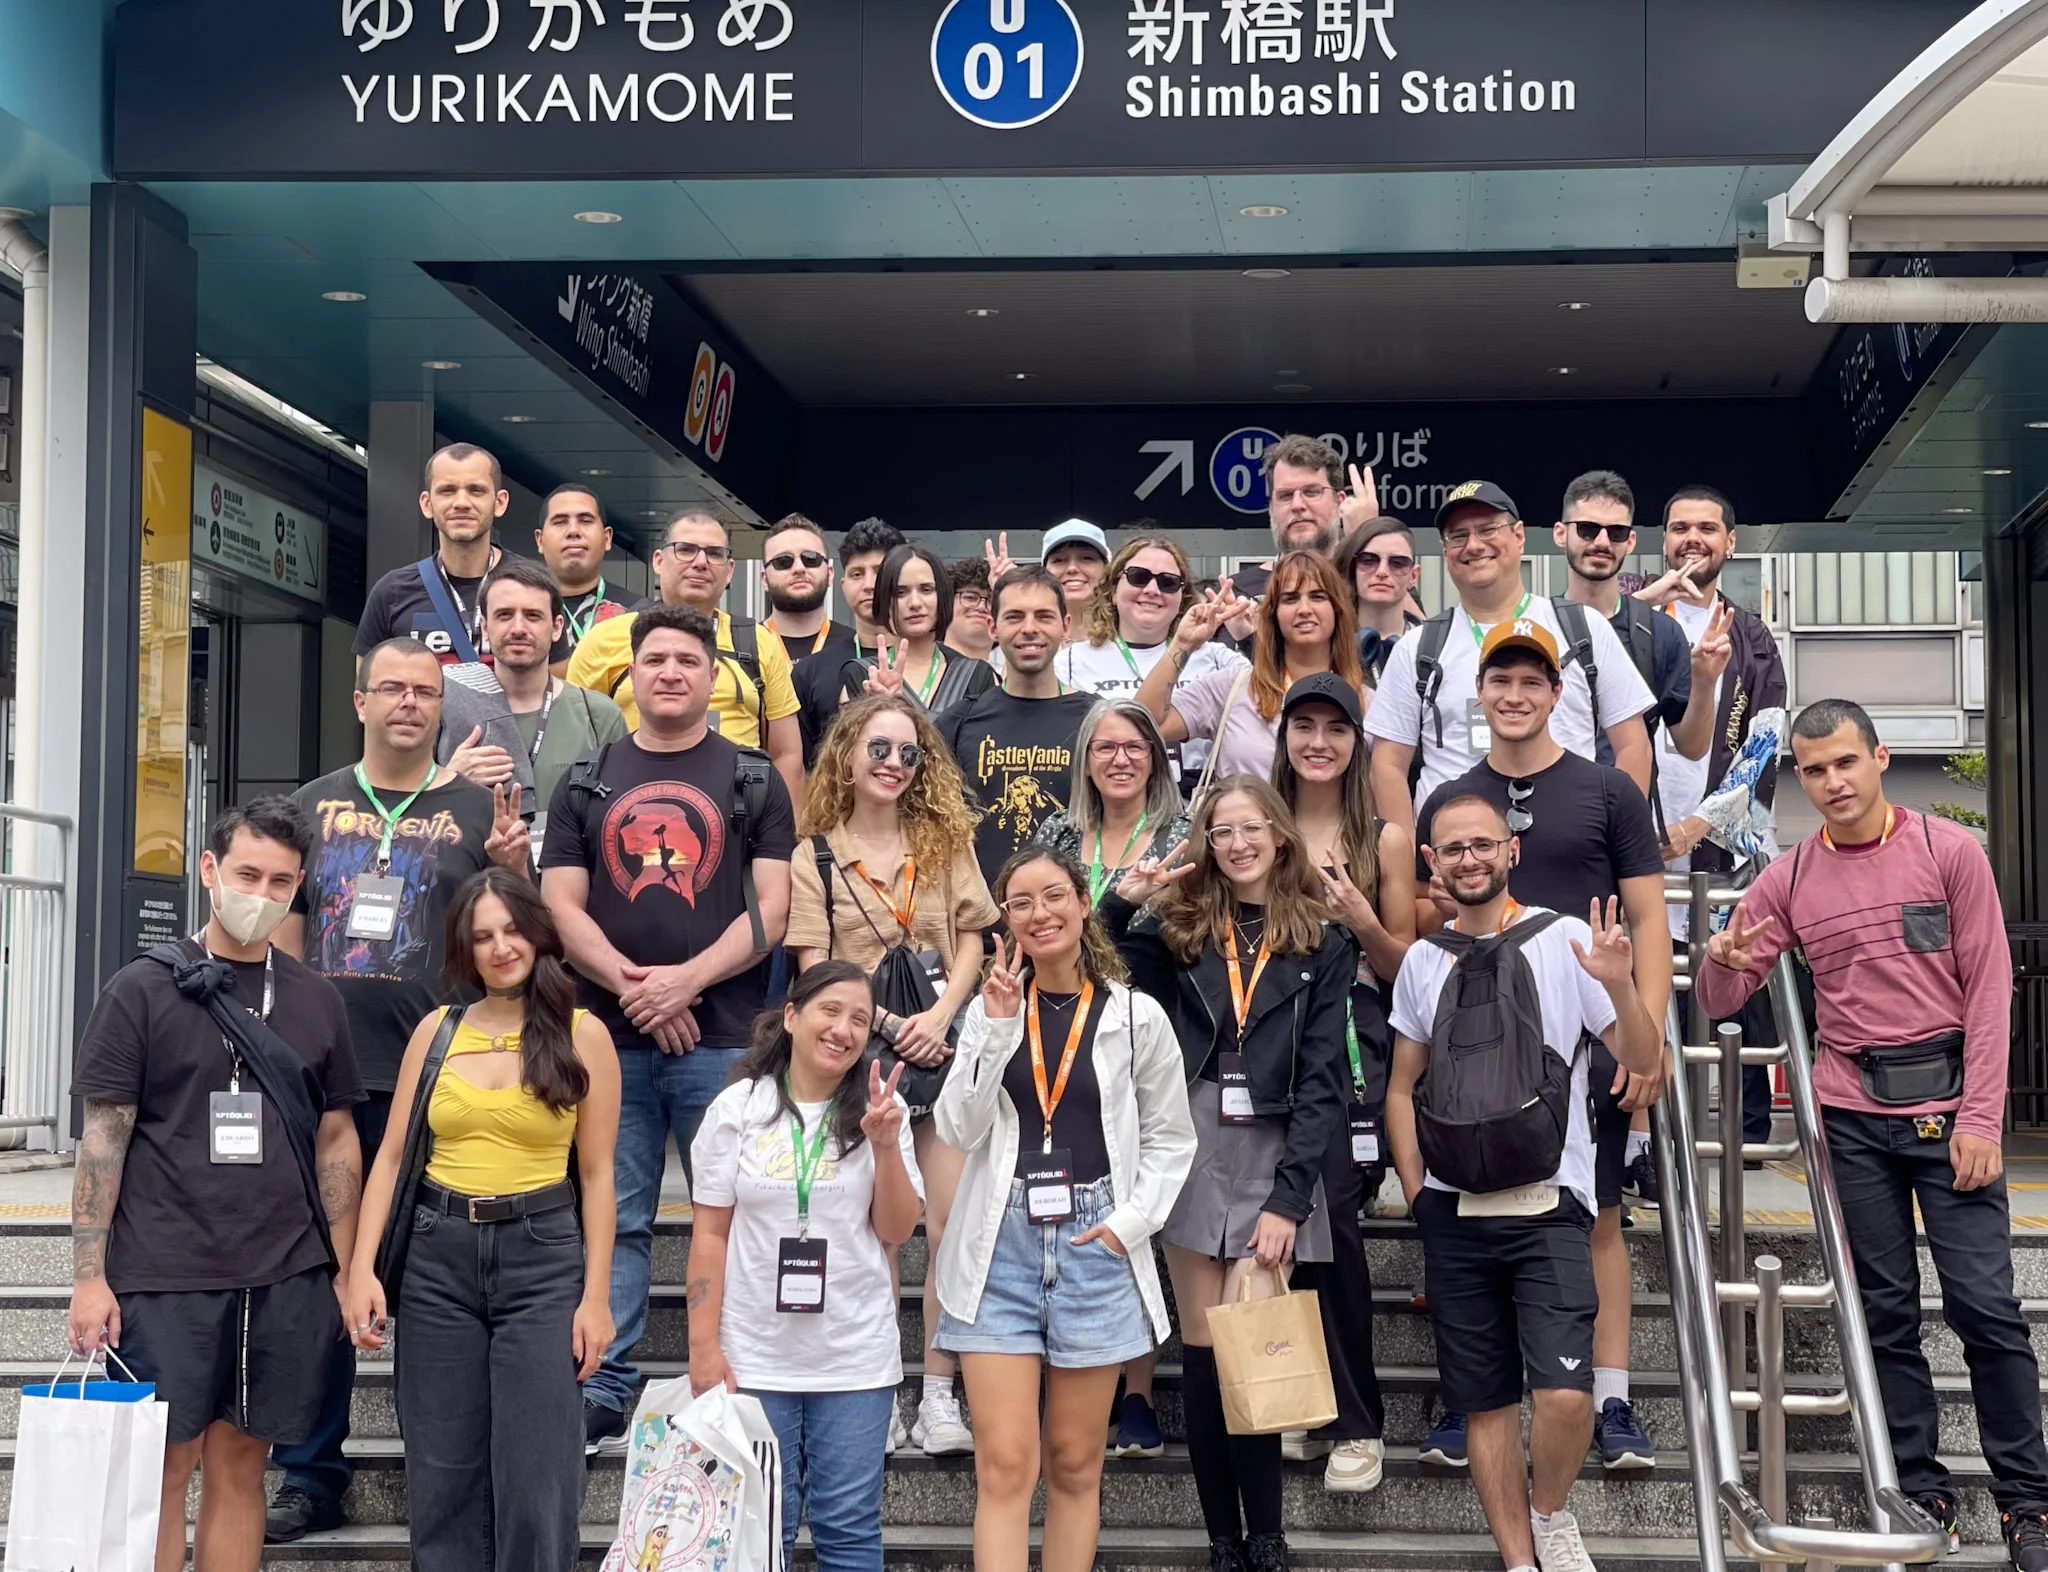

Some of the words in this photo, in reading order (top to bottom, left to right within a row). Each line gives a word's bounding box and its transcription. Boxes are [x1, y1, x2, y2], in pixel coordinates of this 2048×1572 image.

[341, 0, 794, 54] ゆりかもめ
[1126, 0, 1398, 65] 新橋駅
[963, 42, 1046, 101] 01
[1125, 73, 1381, 119] Shimbashi
[1400, 69, 1577, 114] Station
[341, 72, 794, 123] YURIKAMOME
[576, 299, 605, 371] Wing
[602, 325, 653, 398] Shimbashi
[1242, 437, 1264, 460] U
[1317, 428, 1432, 468] のりば
[1344, 473, 1458, 510] form
[810, 1183, 846, 1193] harging
